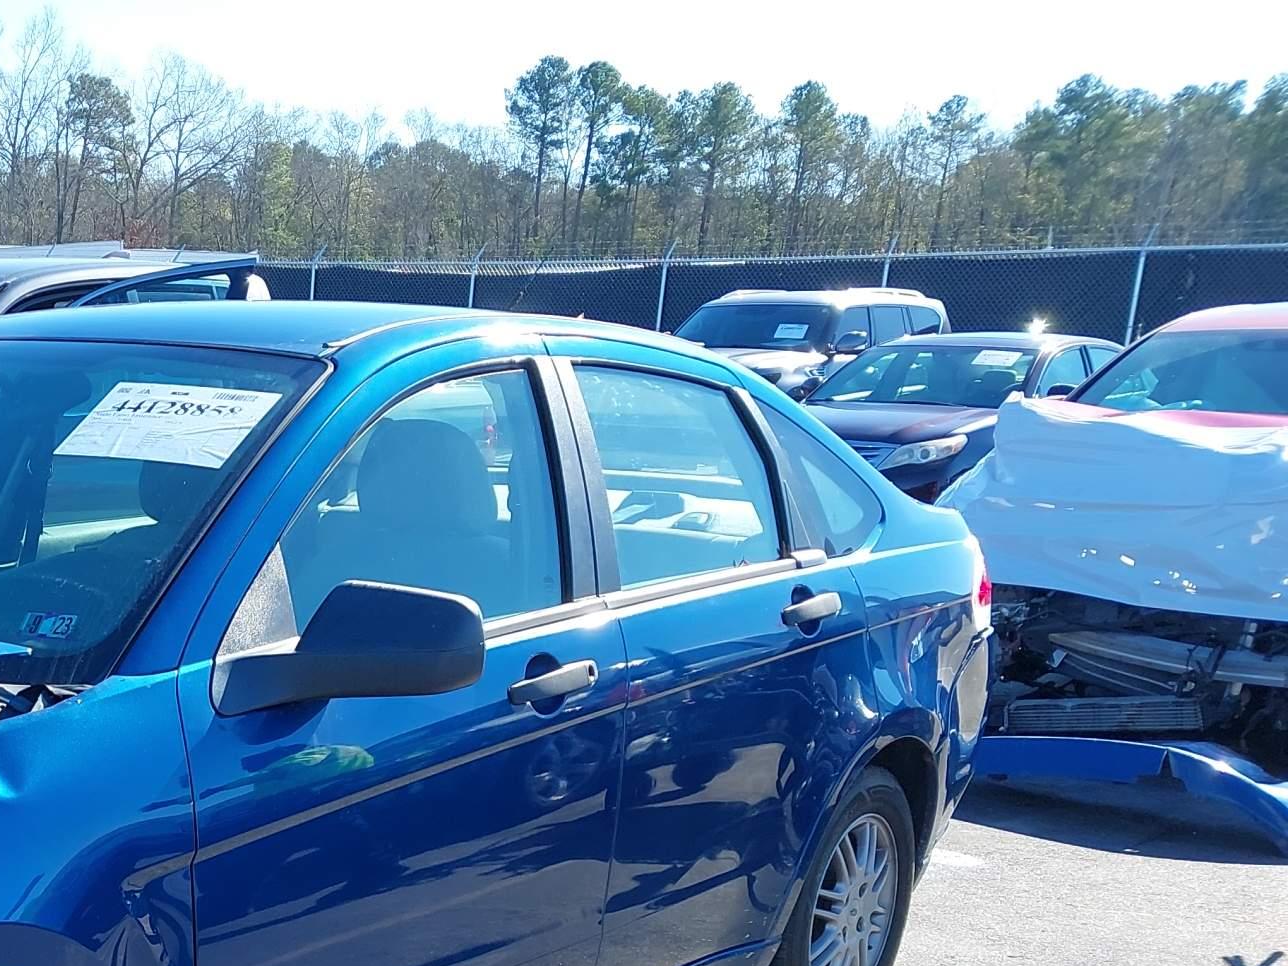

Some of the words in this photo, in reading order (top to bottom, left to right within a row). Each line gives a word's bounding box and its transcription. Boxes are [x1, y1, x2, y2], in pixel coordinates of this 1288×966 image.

[112, 399, 243, 417] 44128858
[28, 614, 43, 634] 9
[52, 616, 74, 635] 23
